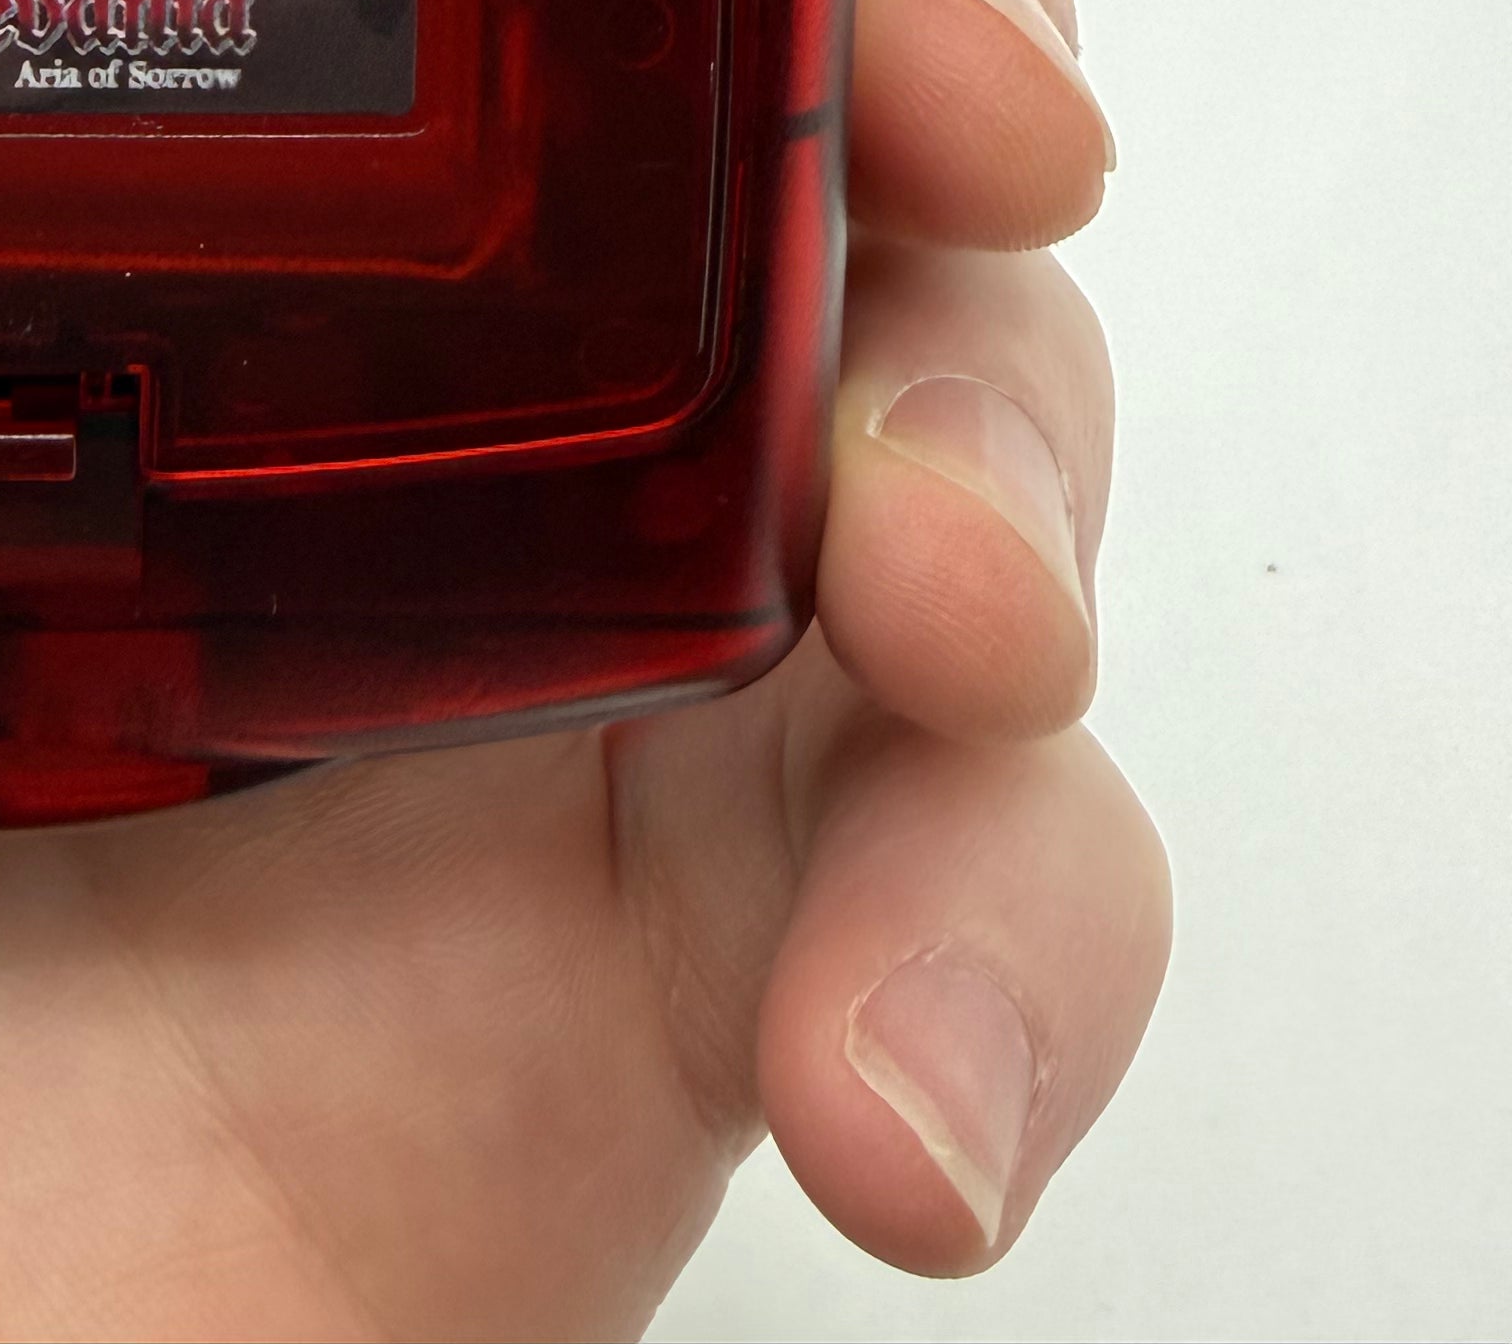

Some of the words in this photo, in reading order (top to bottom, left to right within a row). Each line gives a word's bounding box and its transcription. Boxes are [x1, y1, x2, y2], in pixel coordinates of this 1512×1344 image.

[14, 59, 82, 88] Aria
[88, 59, 122, 88] of
[128, 60, 242, 89] Sorrow
